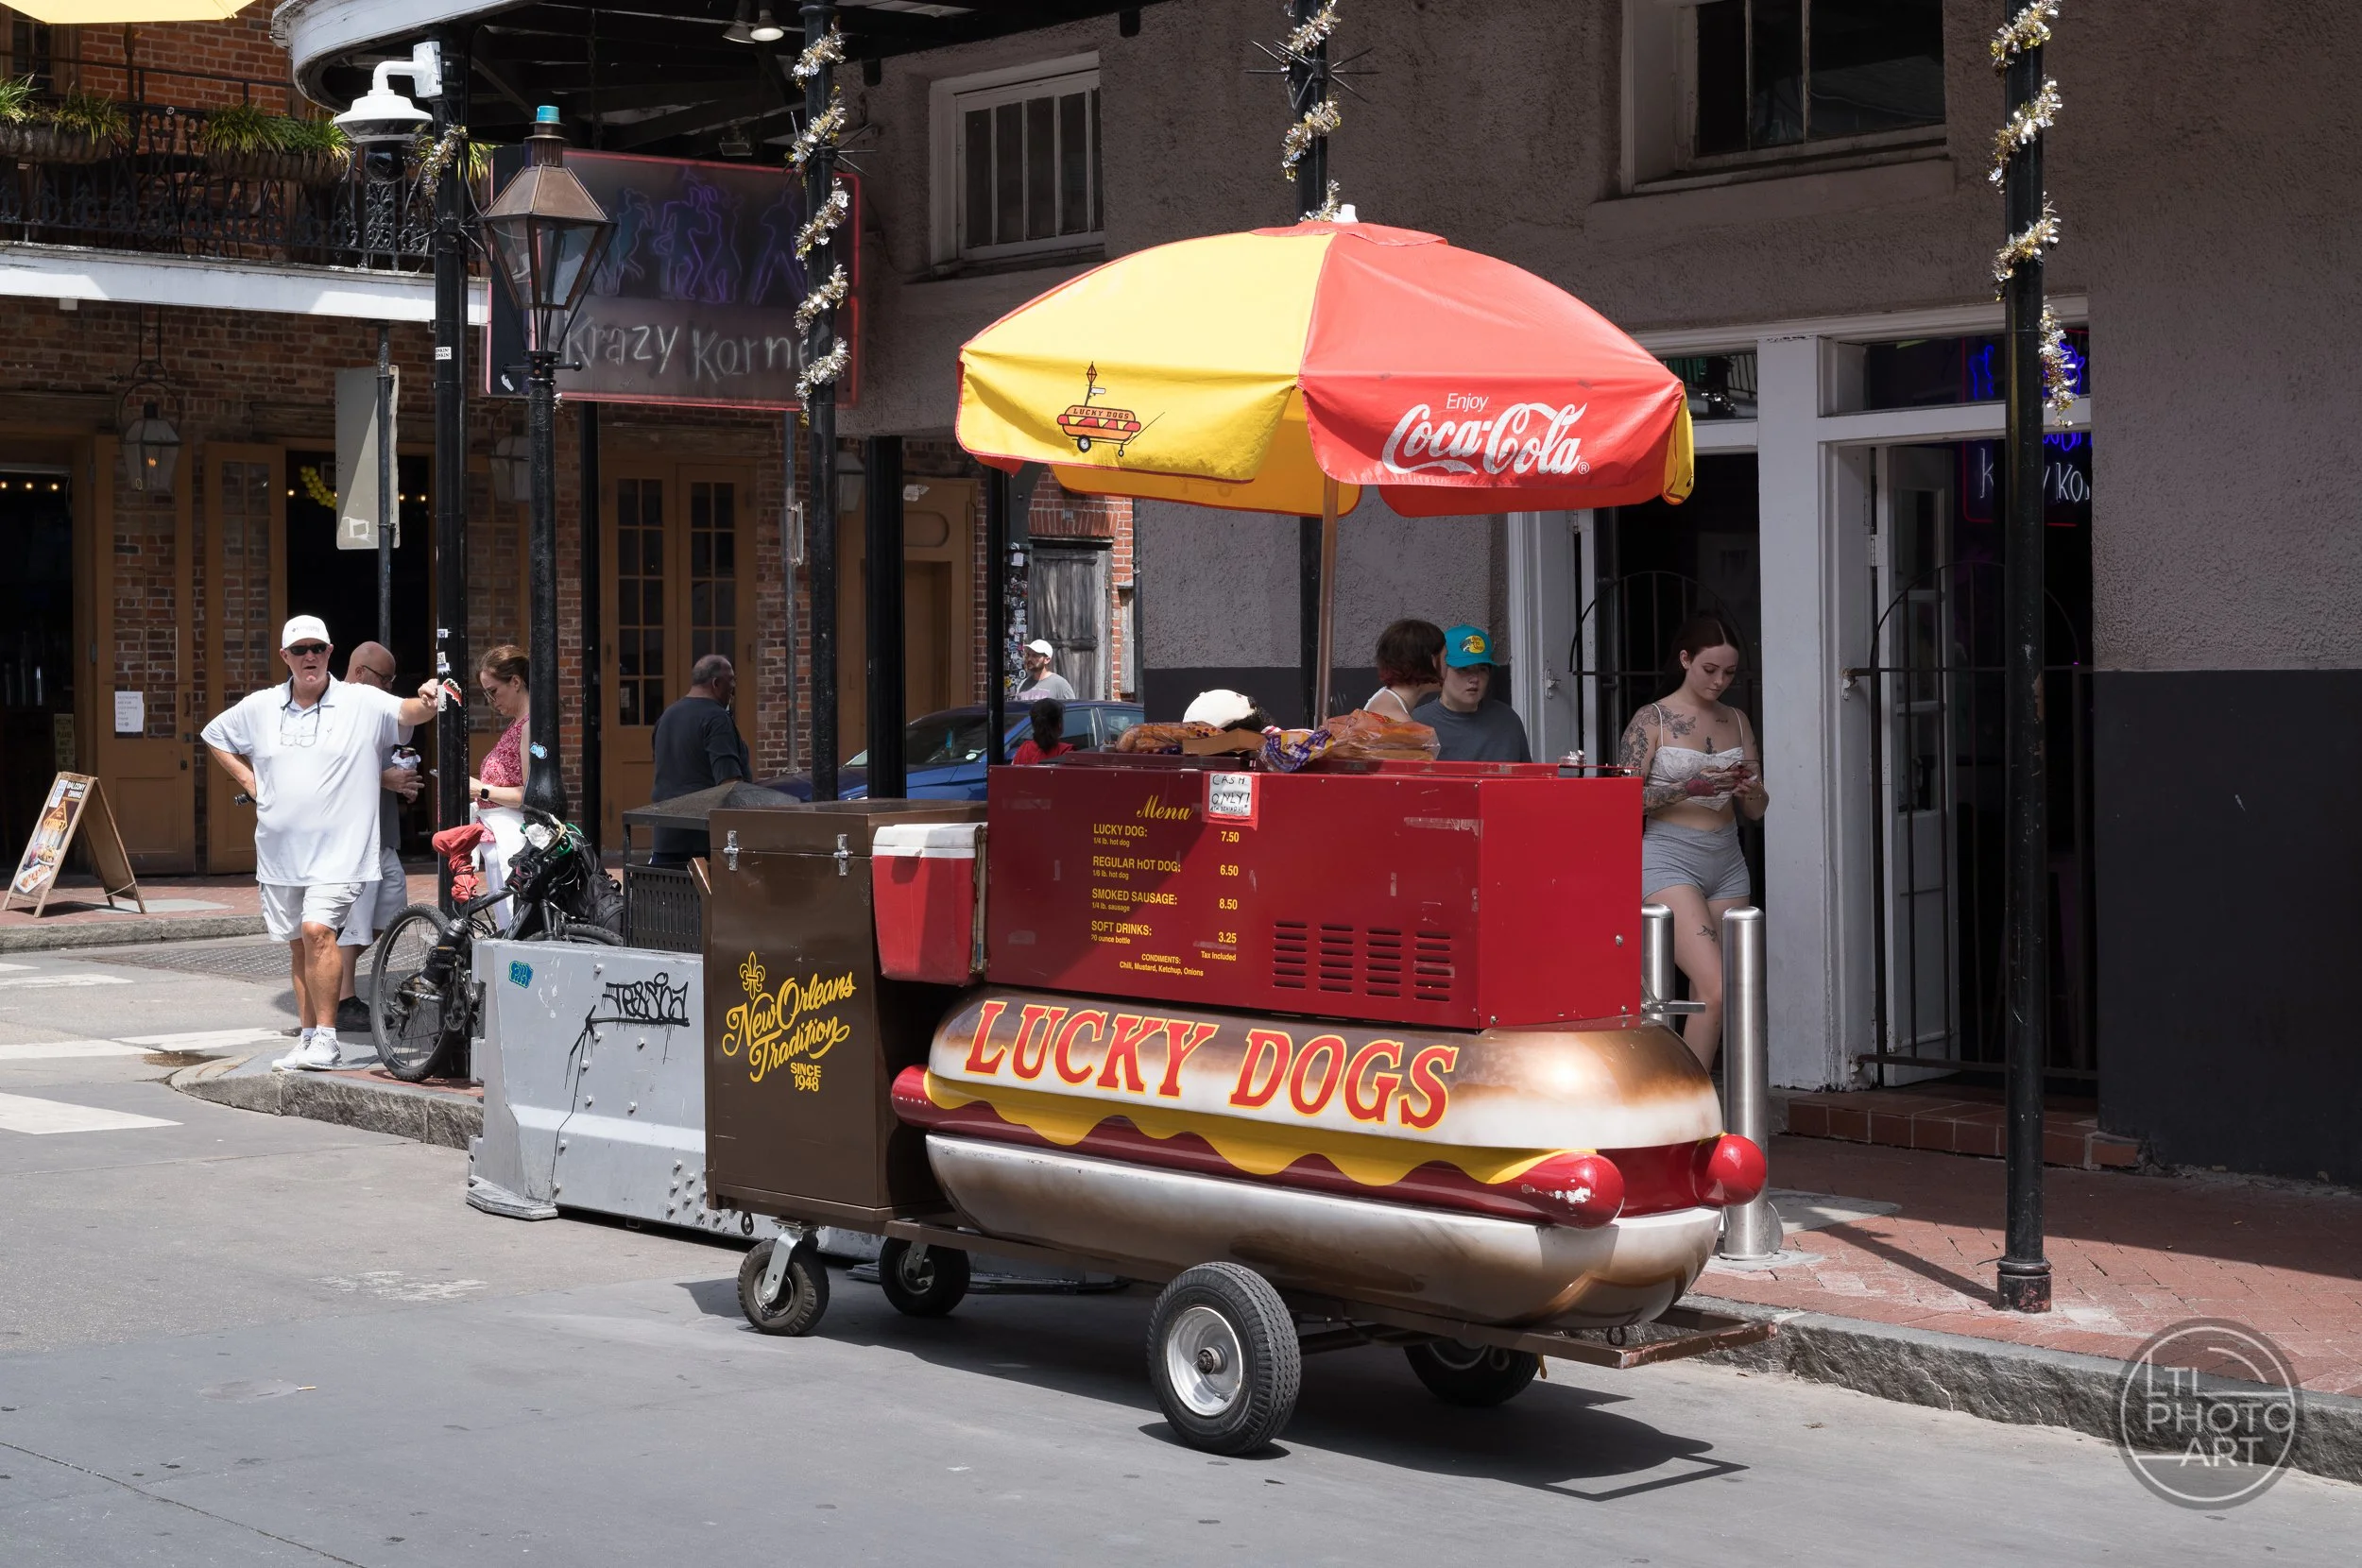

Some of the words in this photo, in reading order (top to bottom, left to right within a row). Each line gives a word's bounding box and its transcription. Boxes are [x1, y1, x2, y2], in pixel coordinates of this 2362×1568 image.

[566, 316, 679, 374] Krazy
[1445, 392, 1489, 413] Enjoy
[1073, 408, 1104, 417] LUCKY
[1212, 774, 1245, 785] CASH
[1211, 792, 1251, 808] ONLY!
[1136, 794, 1193, 821] Menu
[1093, 823, 1122, 835] LUCKY
[1124, 825, 1147, 837] DOG:
[1221, 830, 1240, 843] 7.50
[1120, 839, 1130, 847] dog
[1092, 856, 1135, 869] REGULAR
[1138, 859, 1156, 869] HOT
[1158, 861, 1181, 873] DOG:
[1220, 864, 1239, 877] 6.50
[1109, 870, 1118, 878] hot
[1119, 871, 1129, 880] dog
[1092, 888, 1129, 901] SMOKED
[1131, 891, 1177, 905] SAUSAGE:
[1108, 904, 1130, 912] sausage
[1219, 897, 1238, 911] 8.50
[1091, 920, 1114, 932] SOFT
[1116, 923, 1152, 936] DRINKS:
[1115, 936, 1131, 945] bottle
[1218, 931, 1237, 944] 3.25
[1141, 953, 1181, 964] CONDIMENTS:
[1201, 950, 1210, 959] Tax
[1211, 952, 1236, 962] Included
[1119, 962, 1134, 970] Chili,
[1134, 963, 1157, 973] Mustard,
[1158, 964, 1182, 975] Ketchup,
[1184, 967, 1204, 977] Onions
[722, 992, 778, 1057] New
[777, 971, 857, 1031] Orleans
[749, 1015, 850, 1082] Tradition
[790, 1062, 821, 1077] SINCE
[964, 999, 1221, 1099] LUCKY
[1229, 1029, 1460, 1133] DOGS
[795, 1075, 819, 1092] 1948
